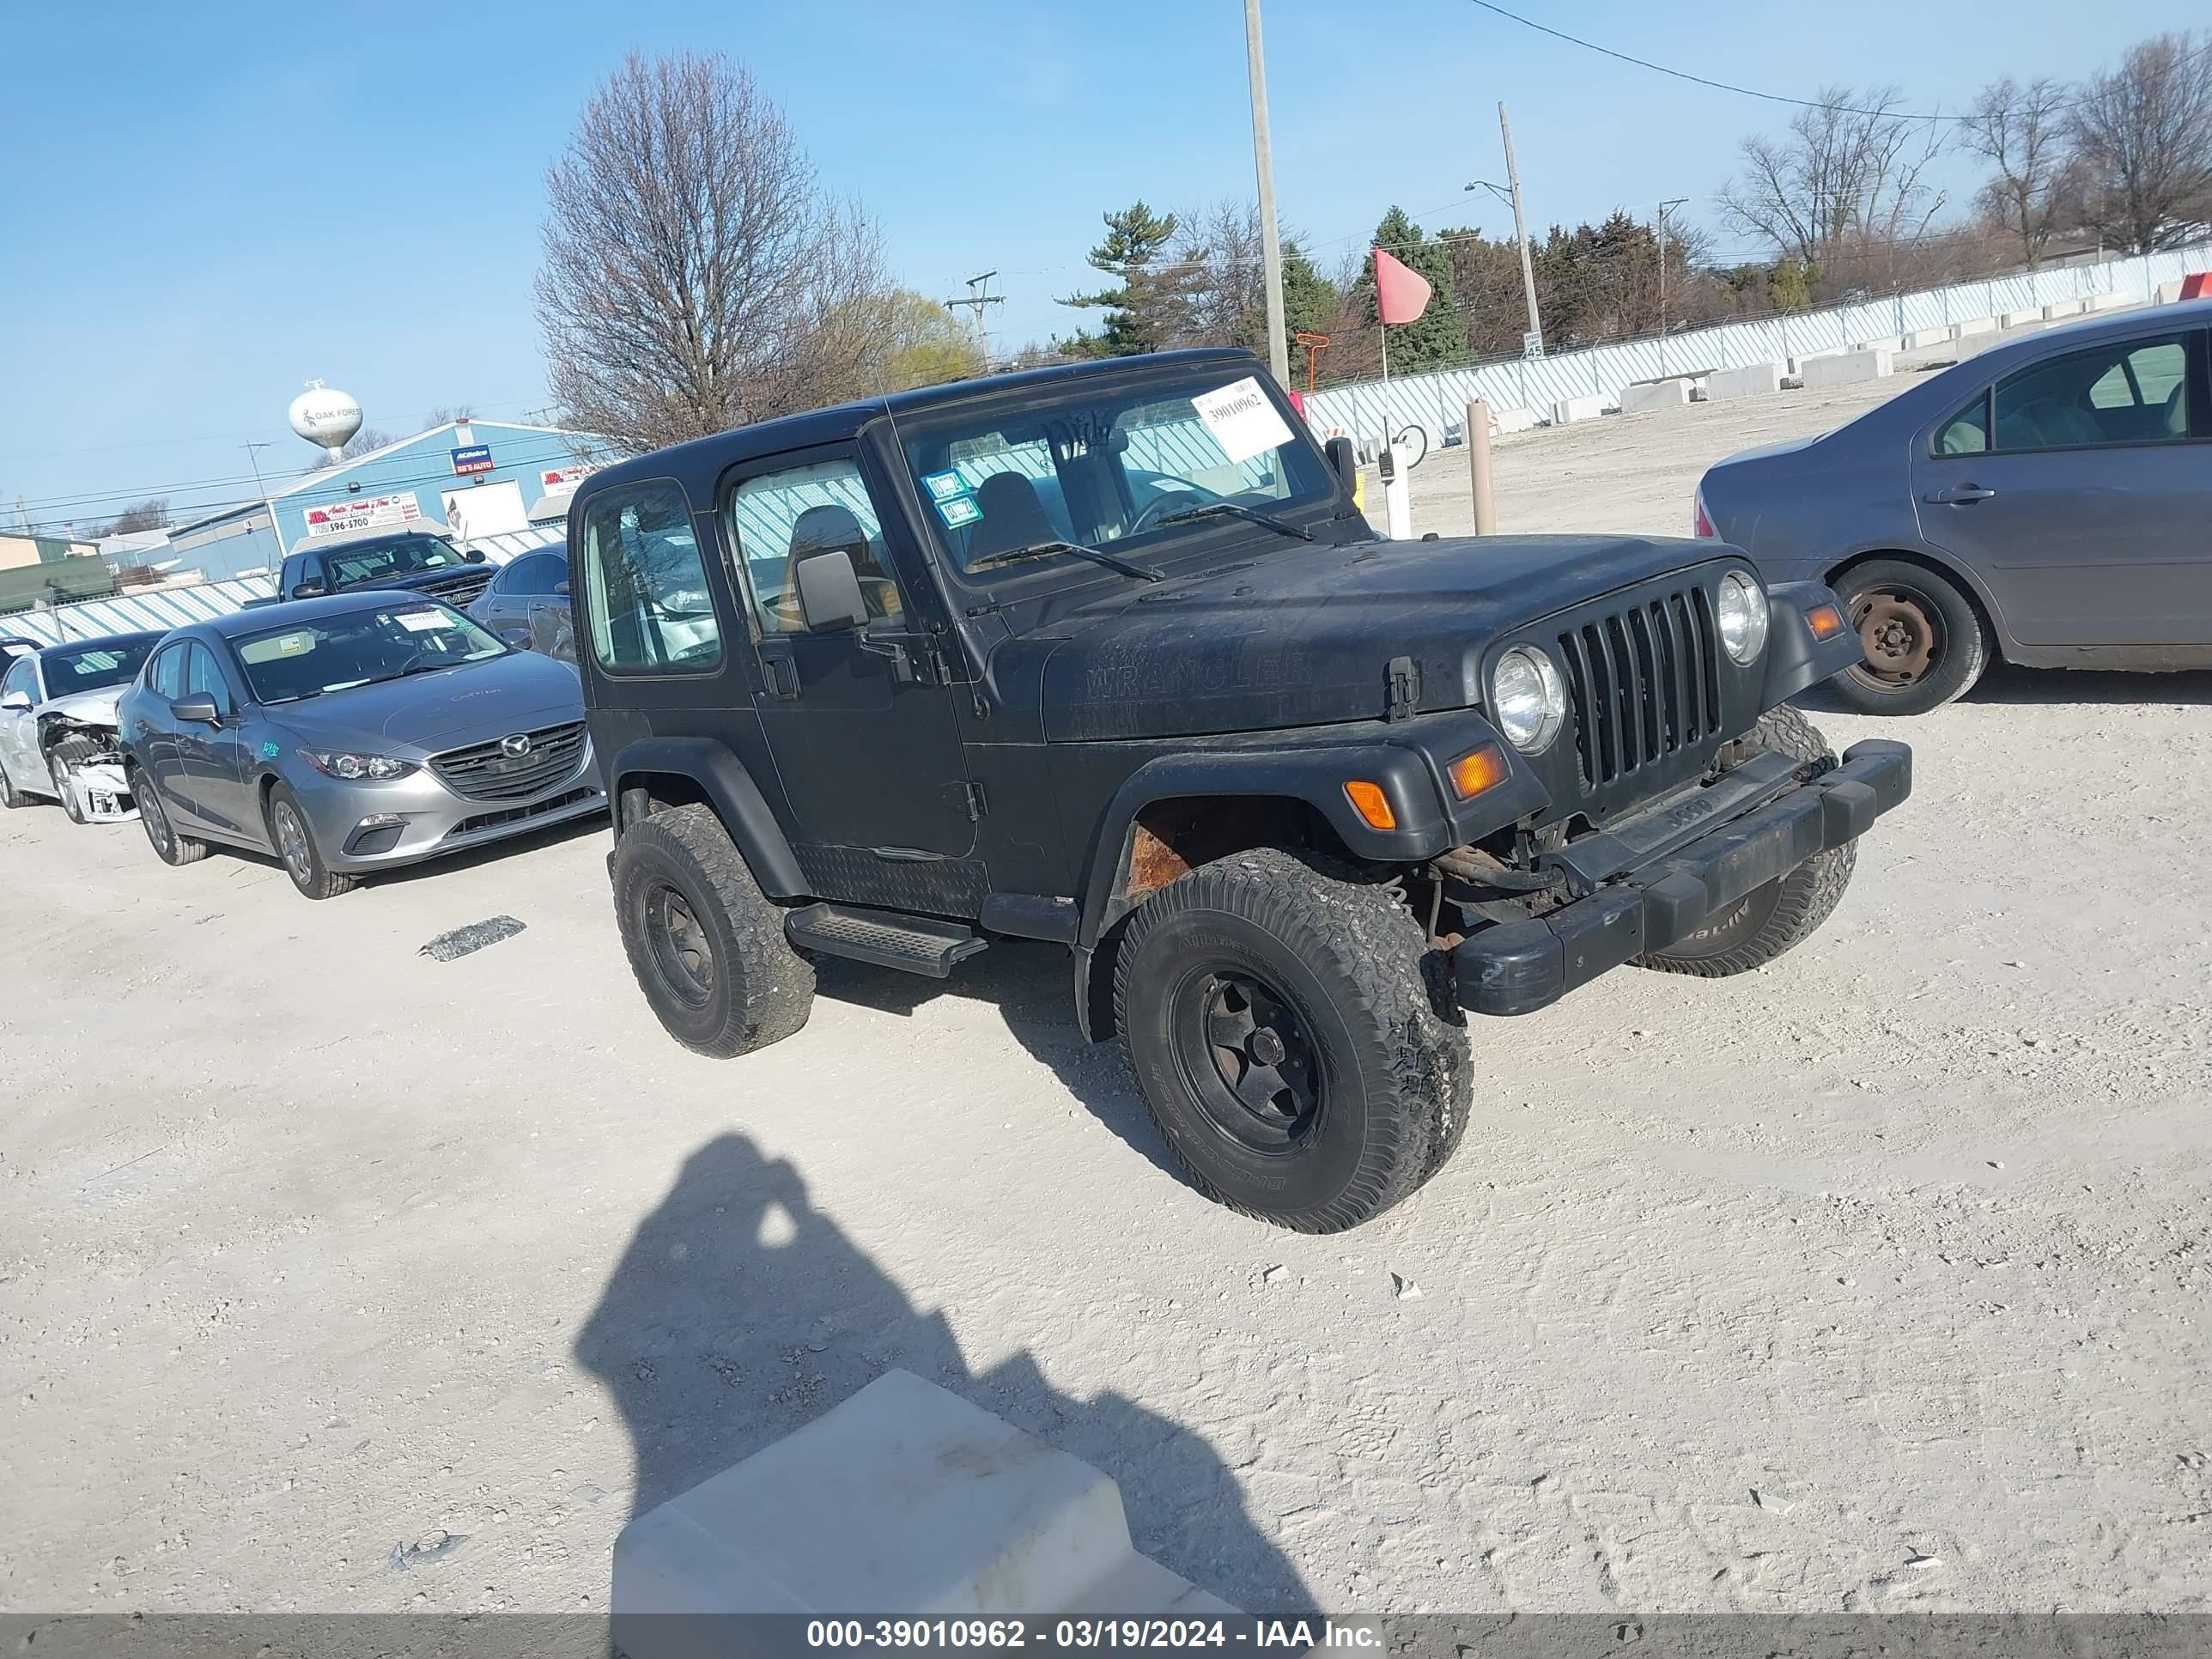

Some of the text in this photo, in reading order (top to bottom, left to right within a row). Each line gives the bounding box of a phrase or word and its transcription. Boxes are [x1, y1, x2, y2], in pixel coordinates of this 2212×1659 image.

[1528, 346, 1542, 357] 45
[315, 411, 336, 420] OAK
[1208, 393, 1262, 422] 39010962
[473, 461, 492, 471] AUTO
[1086, 652, 1314, 697] WRANGLER
[1666, 798, 1715, 830] Jeep
